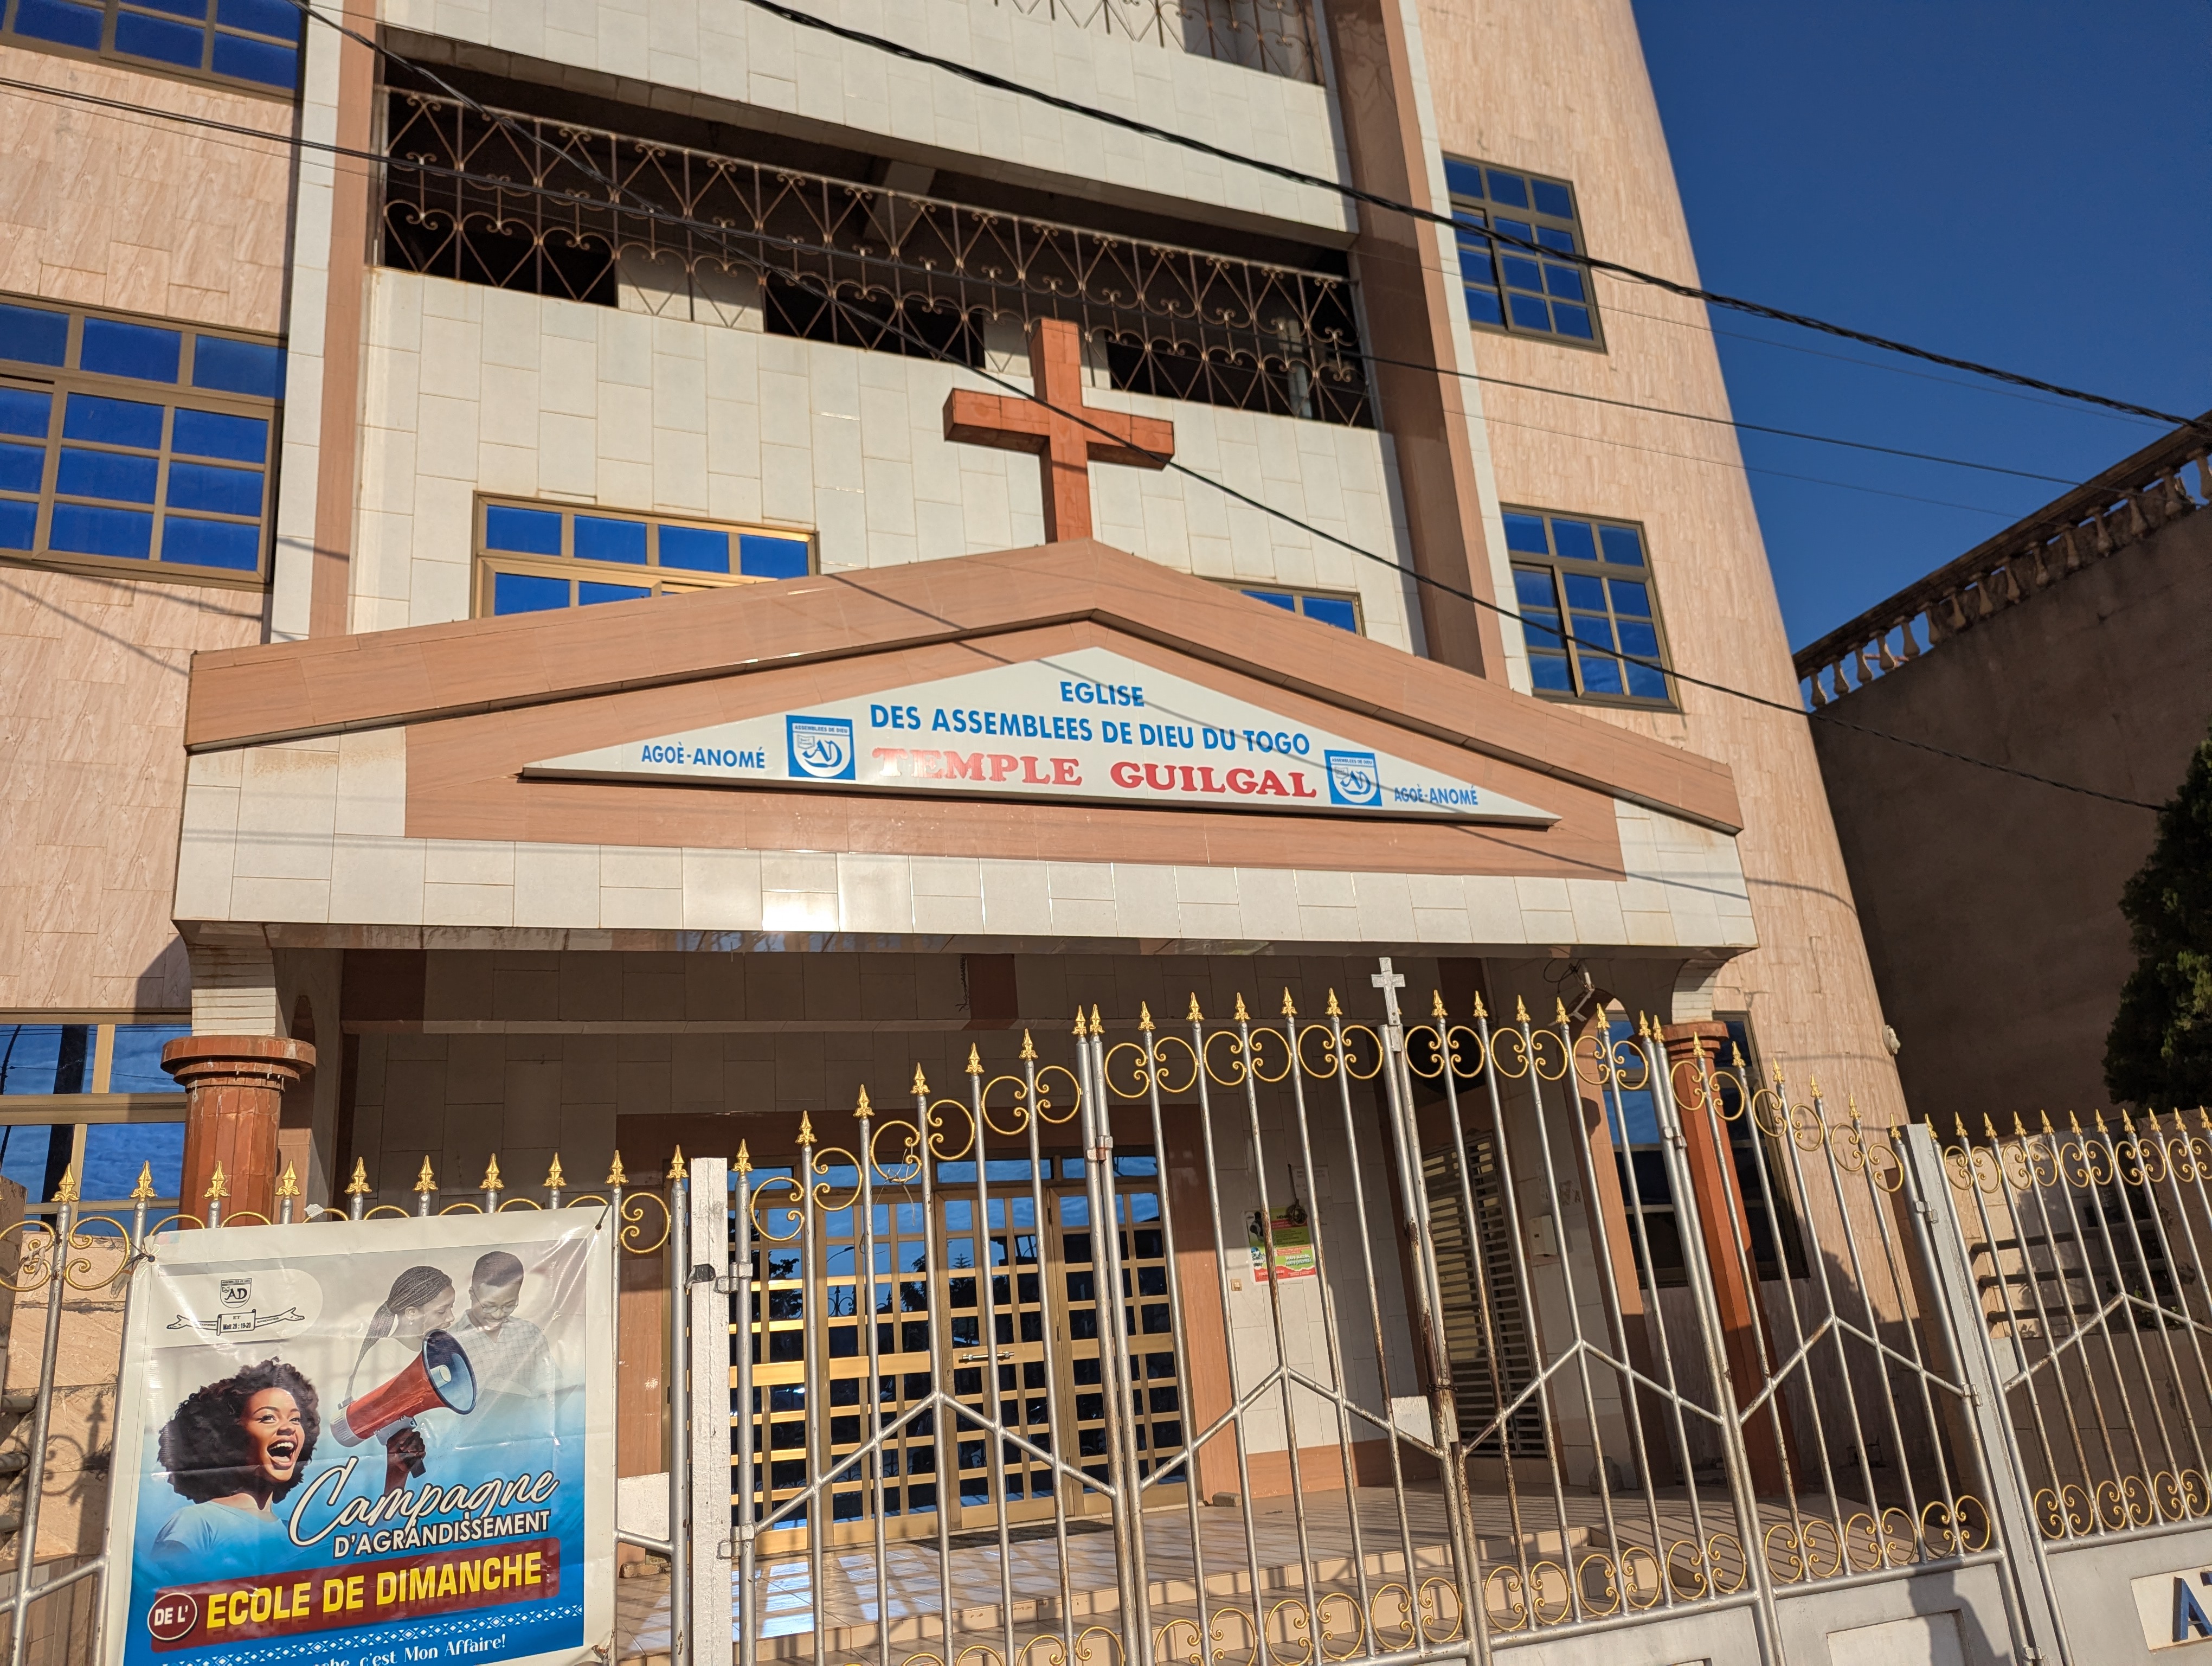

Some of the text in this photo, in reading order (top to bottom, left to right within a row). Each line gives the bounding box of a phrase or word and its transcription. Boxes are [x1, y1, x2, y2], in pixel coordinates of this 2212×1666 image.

[1060, 681, 1144, 707] EGLISE
[871, 704, 1310, 755] DES ASSEMBLEES DE DIEU DU TOGO
[641, 741, 765, 769] AGOÈ-ANOMÉ
[872, 747, 1317, 799] TEMPLE GUILGAL
[1394, 785, 1478, 805] AGOÈ-ANOMÉ
[224, 1288, 247, 1300] AD
[289, 1456, 560, 1546] Campagne
[154, 1607, 173, 1626] DE
[207, 1582, 311, 1629] ECOLE
[323, 1575, 364, 1613] DE
[376, 1551, 542, 1606] DIMANCHE
[2172, 1571, 2212, 1642] A
[404, 1646, 438, 1662] Mon
[445, 1633, 506, 1657] Affaire!
